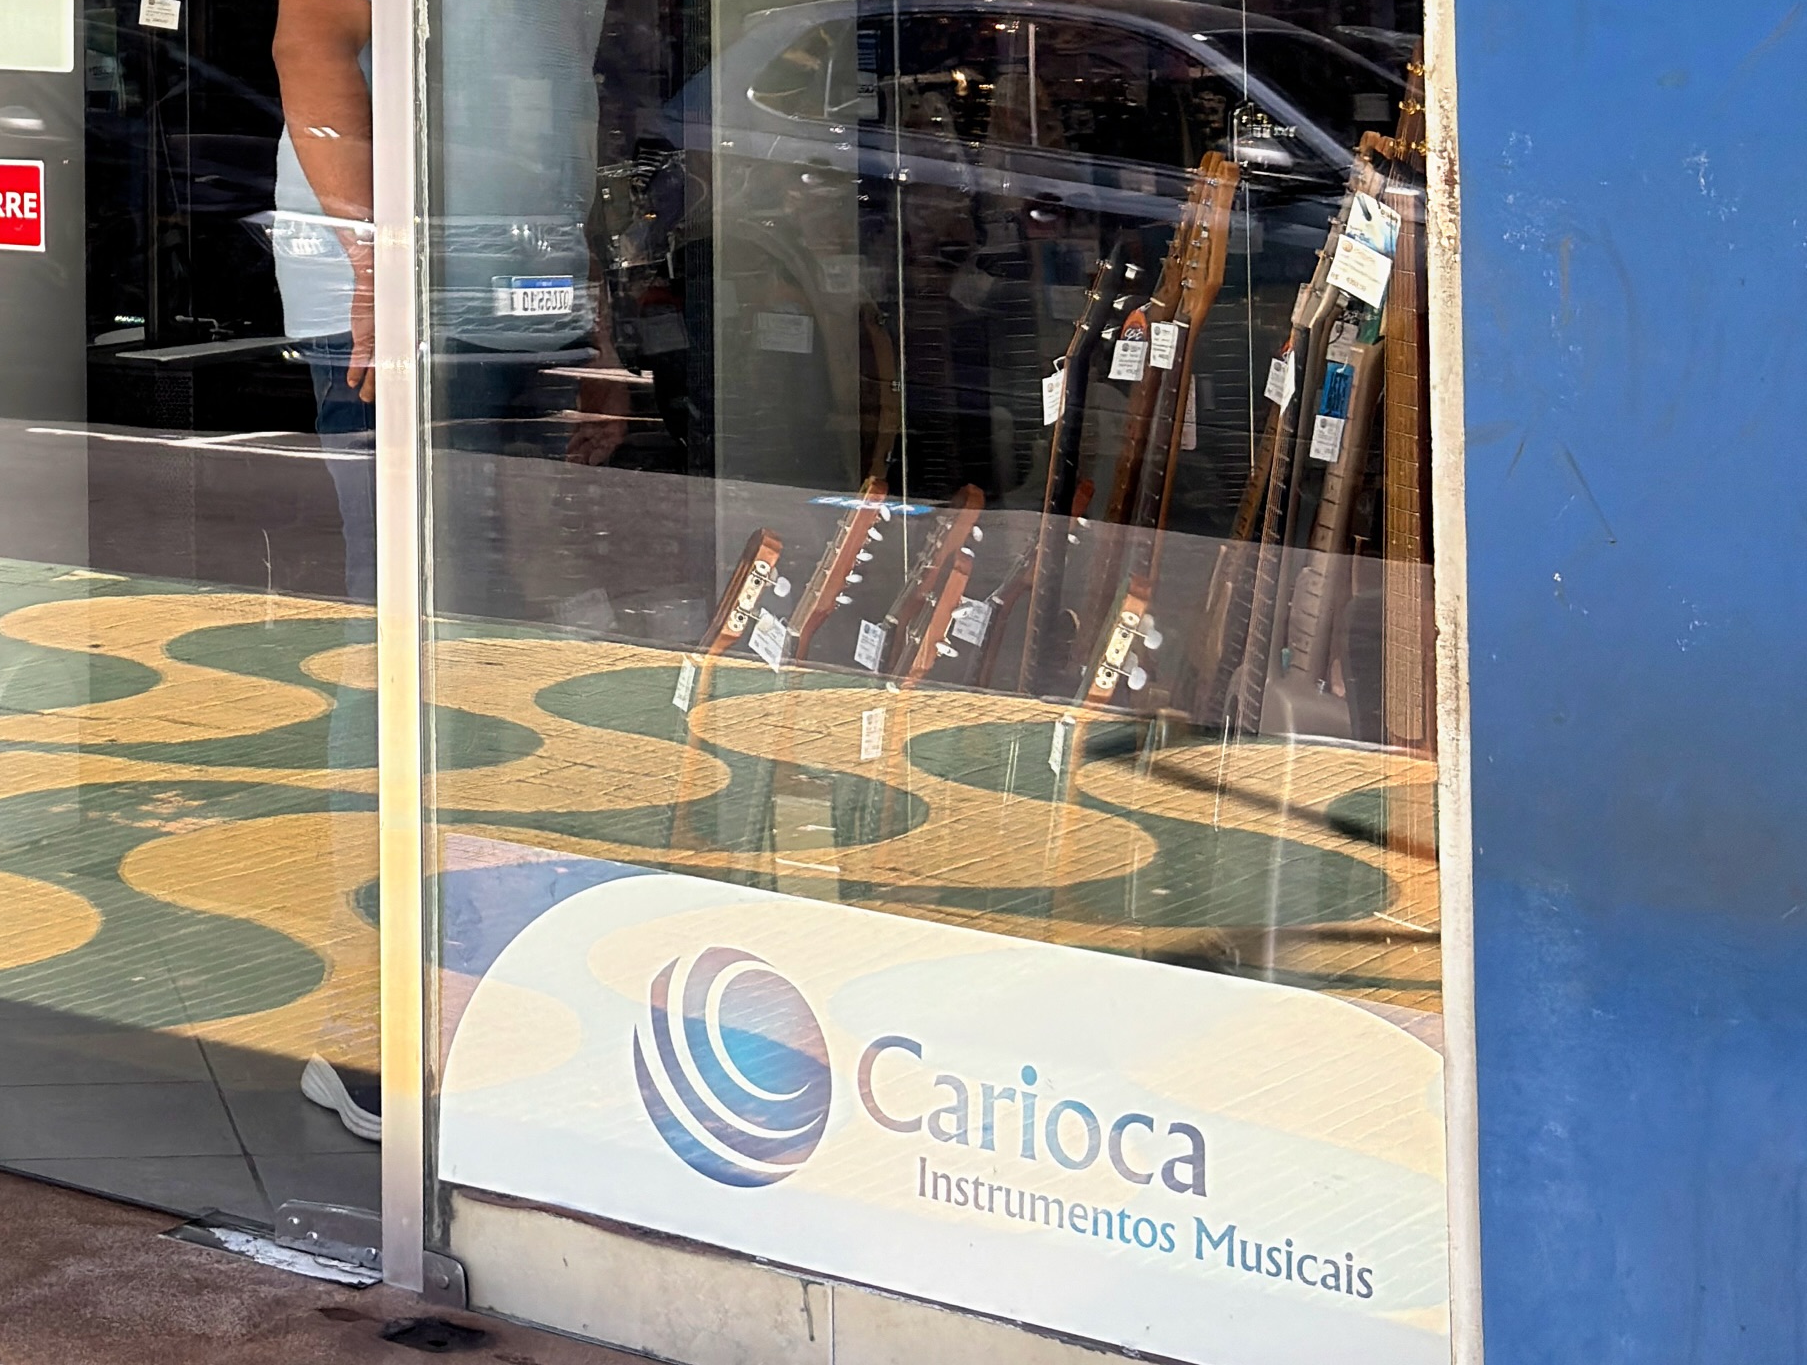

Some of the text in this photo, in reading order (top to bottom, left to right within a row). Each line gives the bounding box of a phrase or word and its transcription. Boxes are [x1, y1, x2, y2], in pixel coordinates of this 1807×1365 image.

[857, 1033, 1209, 1199] Carioca
[917, 1155, 1376, 1301] Instrumentos Musicais
